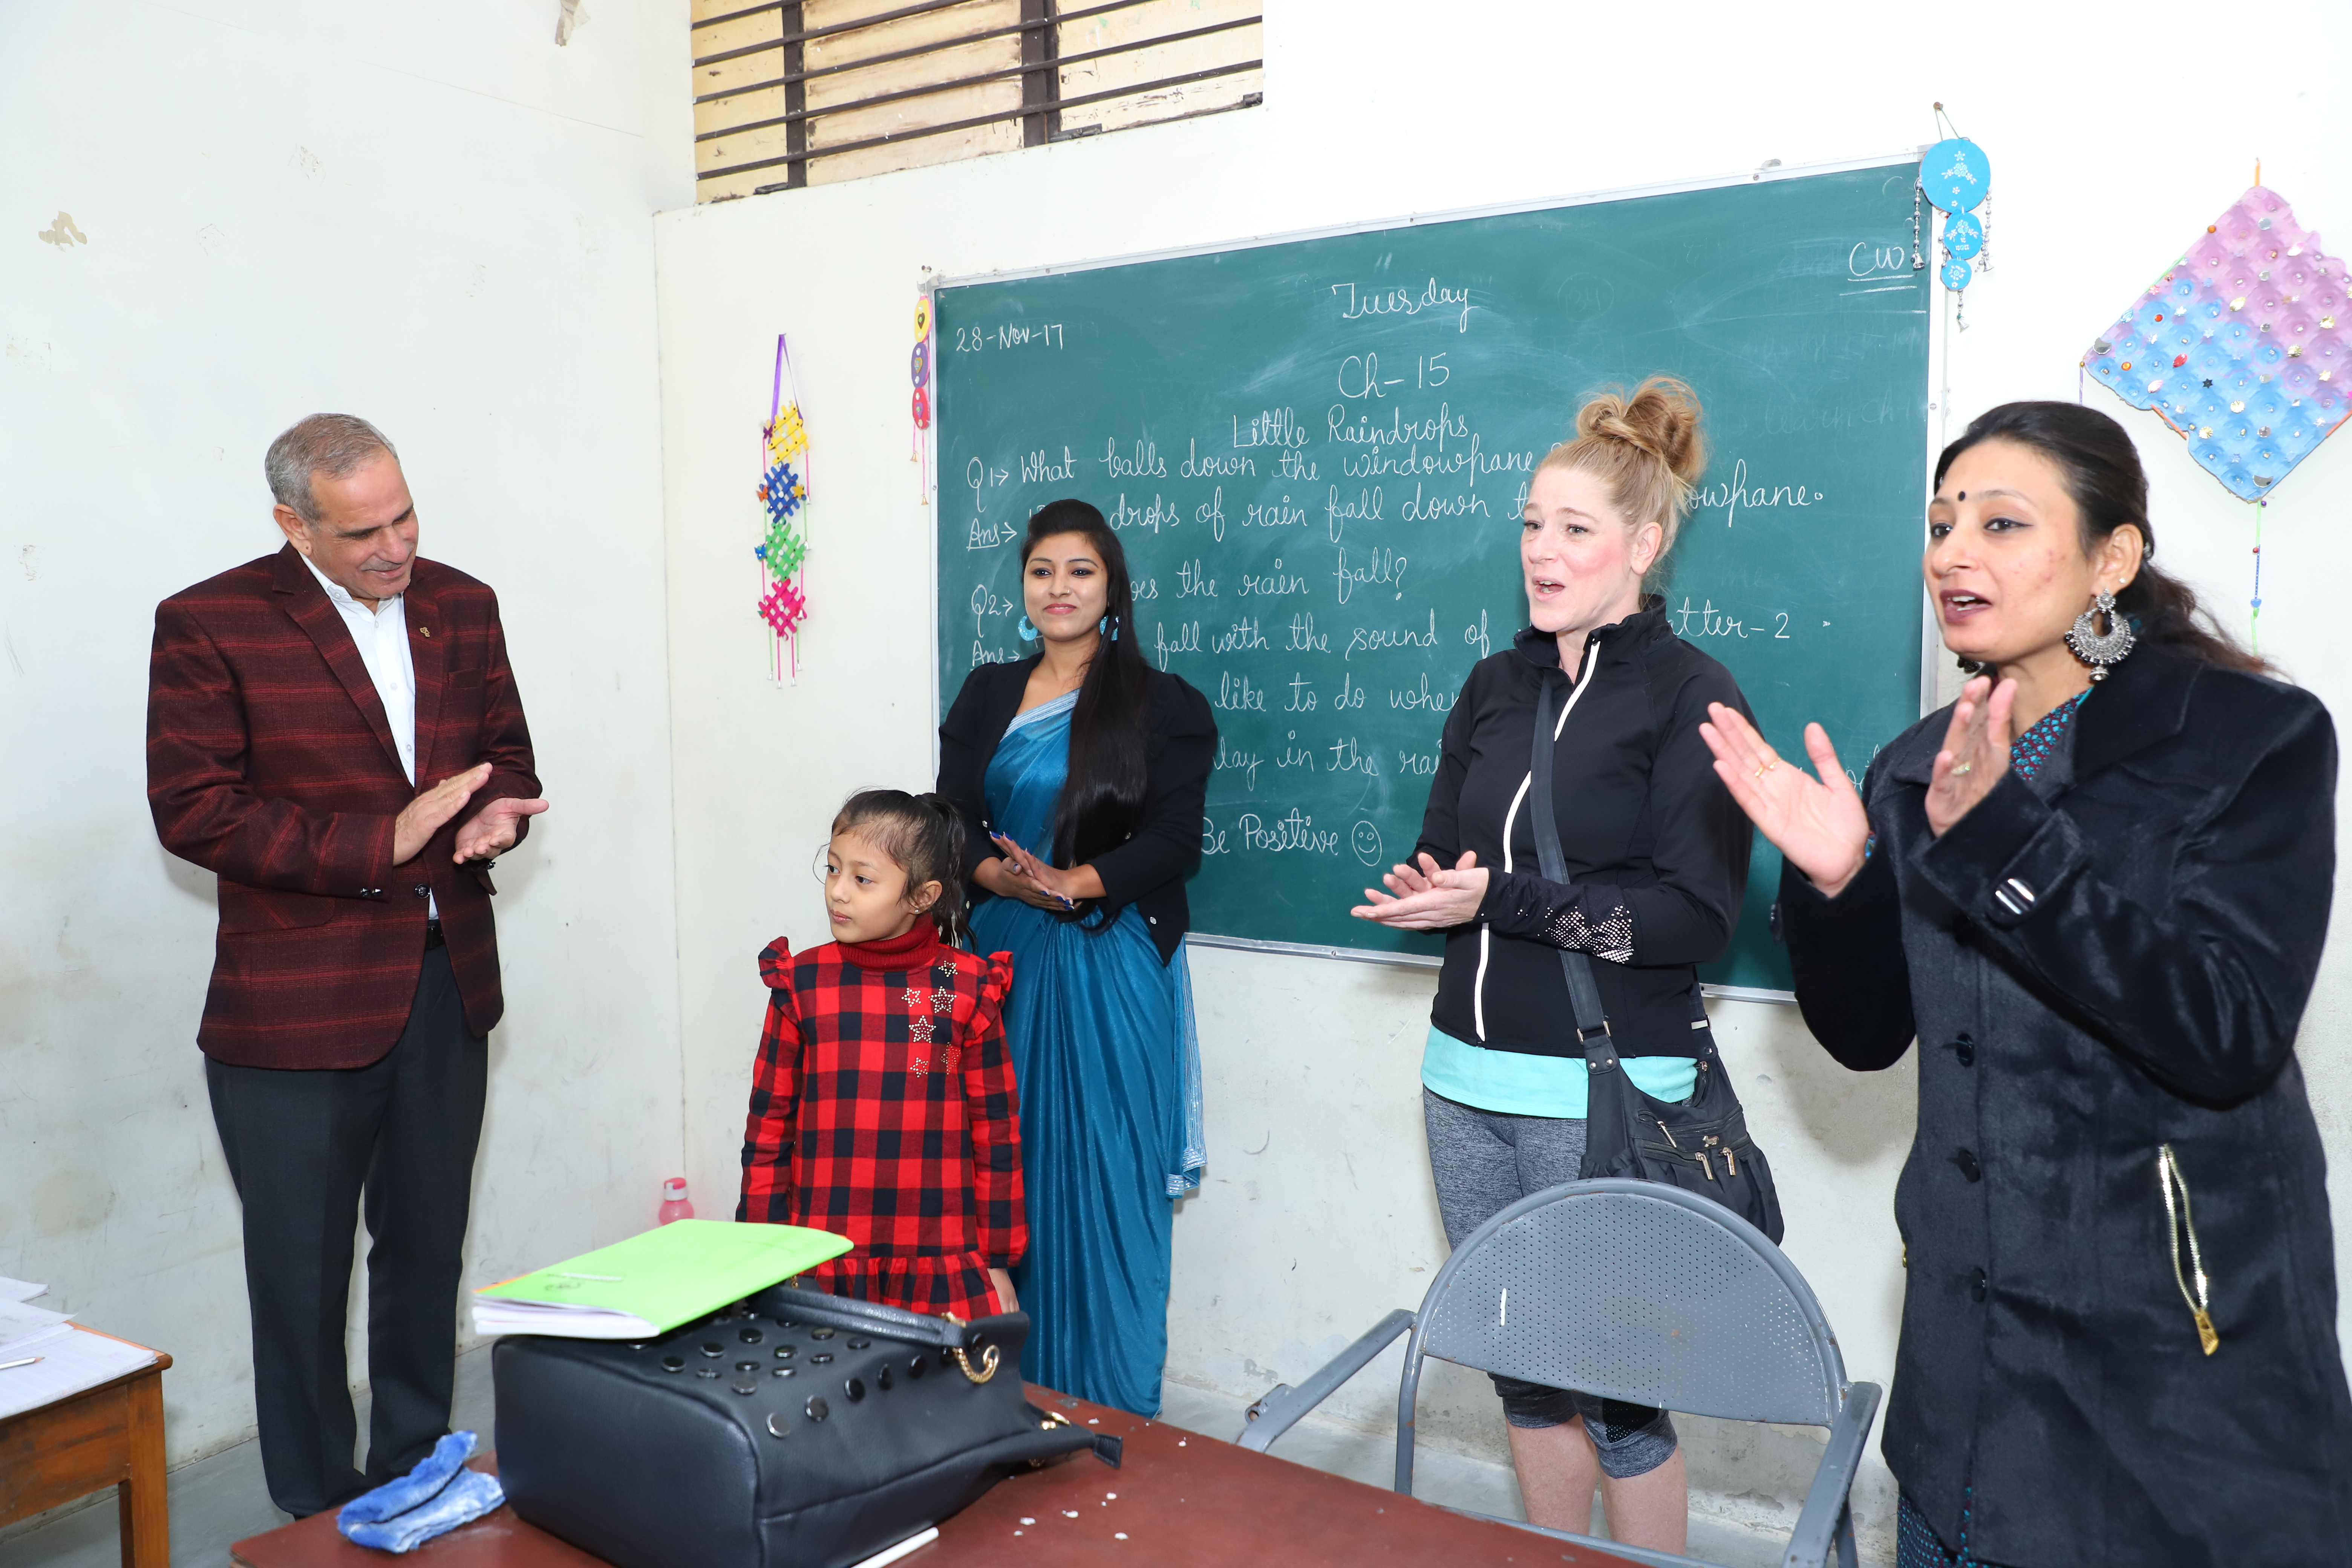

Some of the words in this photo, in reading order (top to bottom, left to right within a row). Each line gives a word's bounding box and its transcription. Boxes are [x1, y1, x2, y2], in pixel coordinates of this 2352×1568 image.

[1332, 277, 1480, 333] Tuesday
[1233, 407, 1310, 448] Little
[1328, 402, 1468, 452] Raindrops
[1020, 446, 1077, 482] What
[1181, 438, 1256, 478] down
[1272, 450, 1320, 481] the
[1110, 493, 1180, 533] drops
[1196, 486, 1225, 542] of
[1242, 495, 1308, 527] rain
[1325, 484, 1384, 543] fall
[1402, 482, 1491, 521] down
[1130, 578, 1159, 601] oes
[1176, 559, 1218, 598] the
[1238, 559, 1310, 596] rain
[1333, 547, 1407, 604] fall?
[1154, 622, 1203, 672] fall
[1212, 616, 1270, 654] with
[1286, 612, 1331, 653] the
[1345, 608, 1438, 661] sound
[1465, 608, 1490, 659] of
[1215, 671, 1266, 711] like
[1285, 672, 1318, 711] to
[1335, 672, 1366, 710] do
[1213, 736, 1265, 791] lay
[1277, 730, 1314, 772] in
[1327, 737, 1378, 776] the
[1239, 807, 1338, 856] Positive
